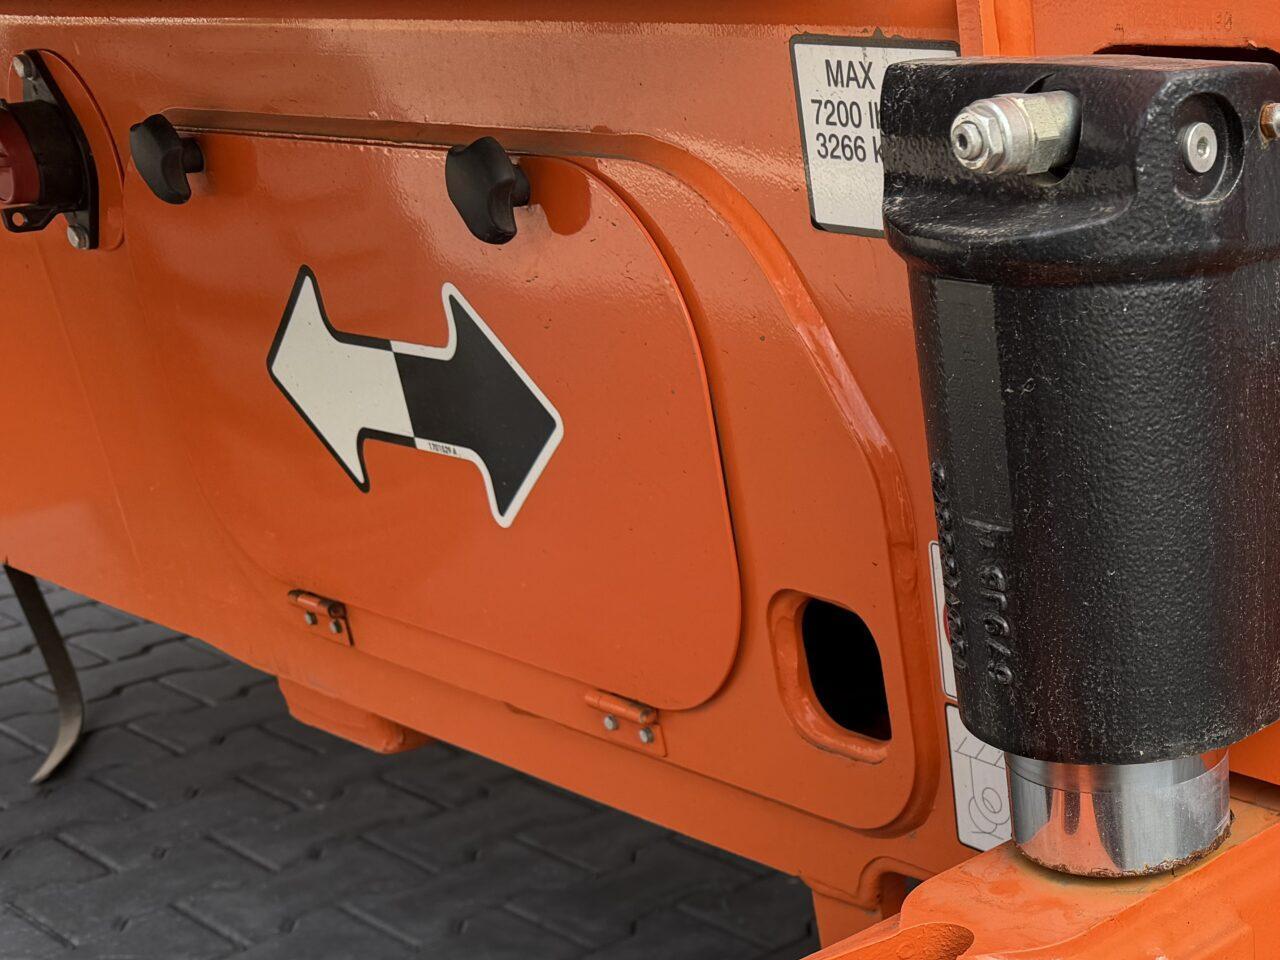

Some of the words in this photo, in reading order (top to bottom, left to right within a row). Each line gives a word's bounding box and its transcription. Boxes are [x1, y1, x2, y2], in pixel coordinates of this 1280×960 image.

[825, 59, 876, 90] MAX
[811, 99, 862, 129] 7200
[816, 132, 867, 162] 3266
